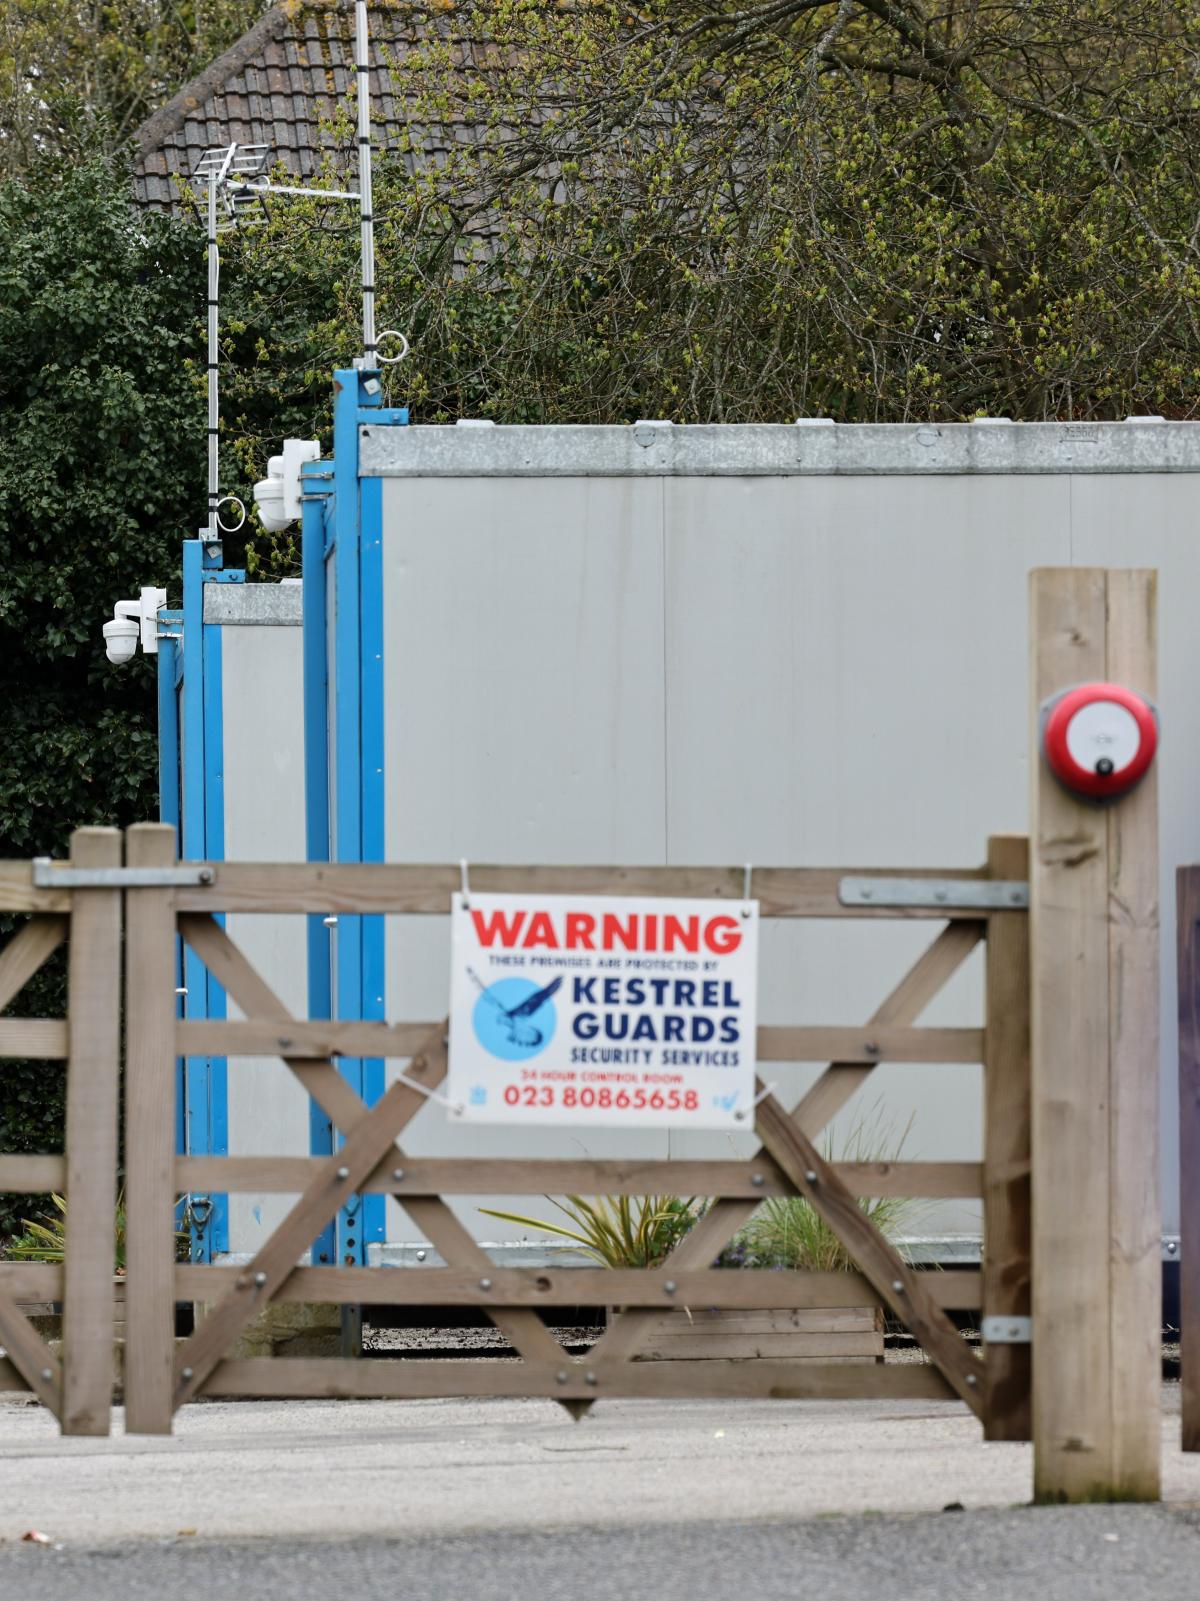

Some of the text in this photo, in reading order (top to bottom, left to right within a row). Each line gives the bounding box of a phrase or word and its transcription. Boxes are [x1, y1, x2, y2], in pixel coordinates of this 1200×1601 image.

[471, 910, 743, 955] WARNING
[573, 976, 741, 1007] KESTREL
[572, 1012, 740, 1043] GUARDS
[571, 1046, 740, 1066] SECURITY SERVICES
[504, 1085, 699, 1110] 023 80865658
